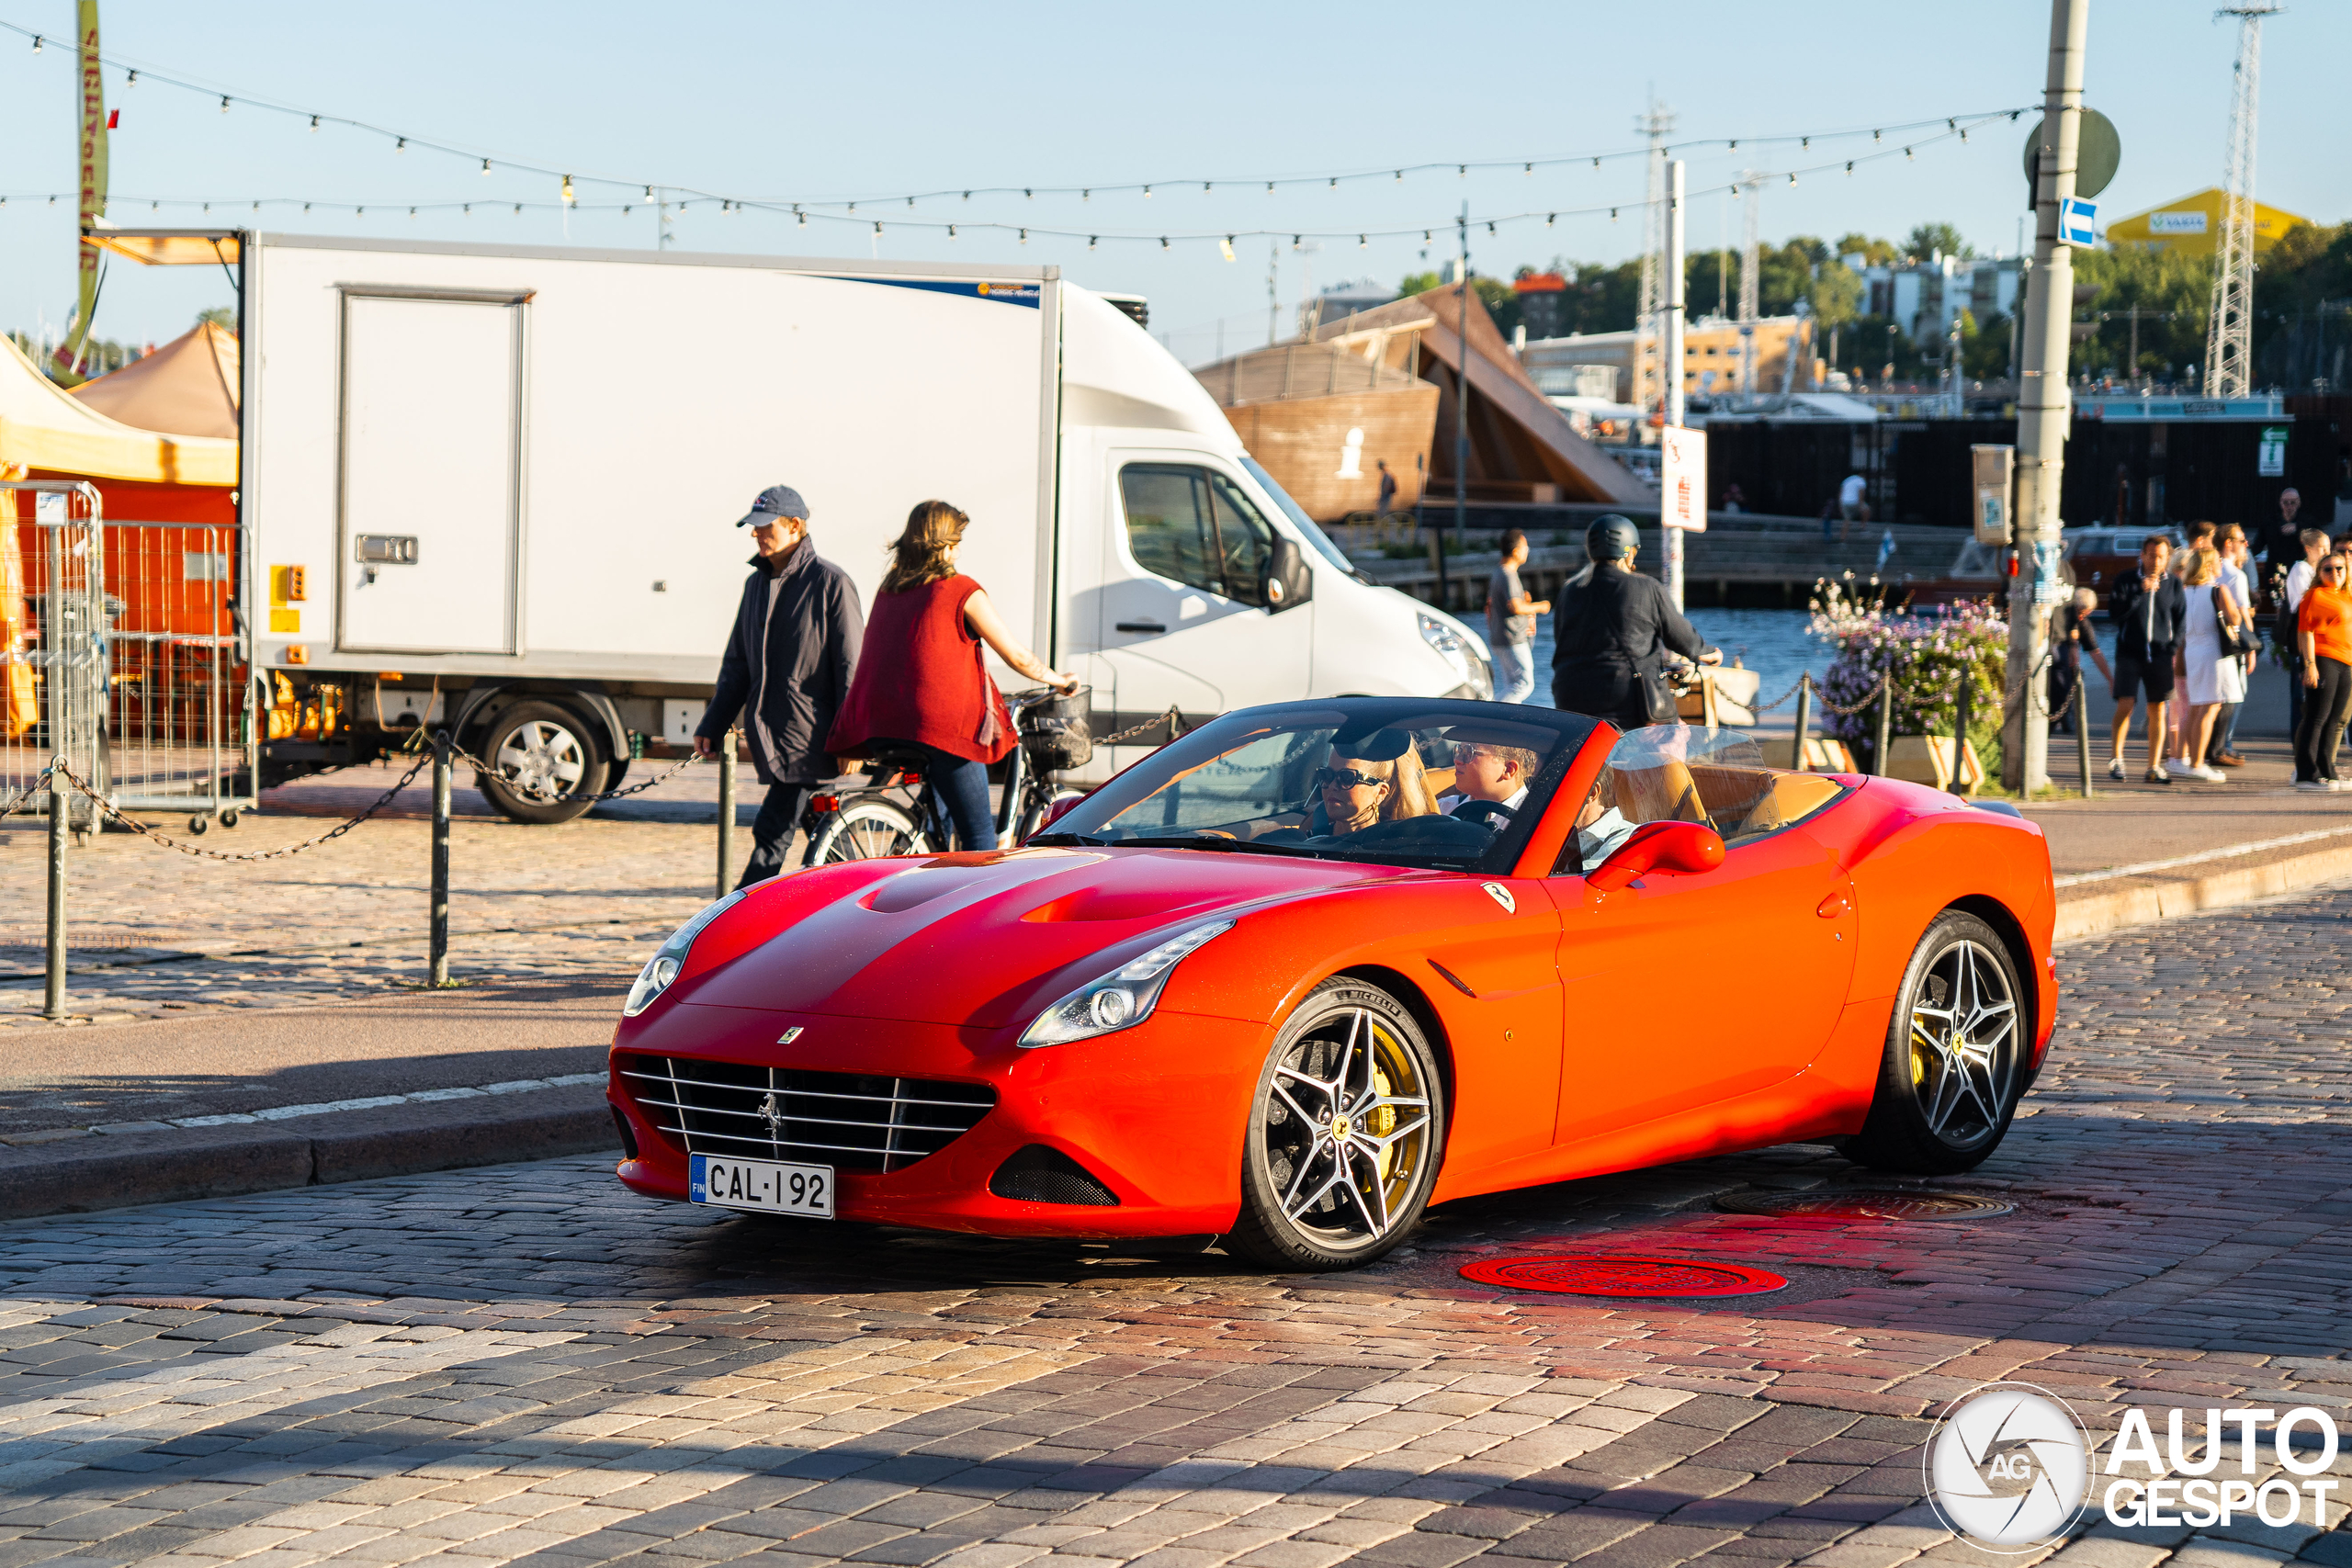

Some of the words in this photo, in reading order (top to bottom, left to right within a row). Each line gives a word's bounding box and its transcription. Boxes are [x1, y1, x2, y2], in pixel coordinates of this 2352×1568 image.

[1349, 990, 1399, 1016] MICHELIN
[692, 1182, 706, 1194] FIN
[710, 1164, 825, 1209] CAL-192
[1296, 1246, 1350, 1266] MICHELIN
